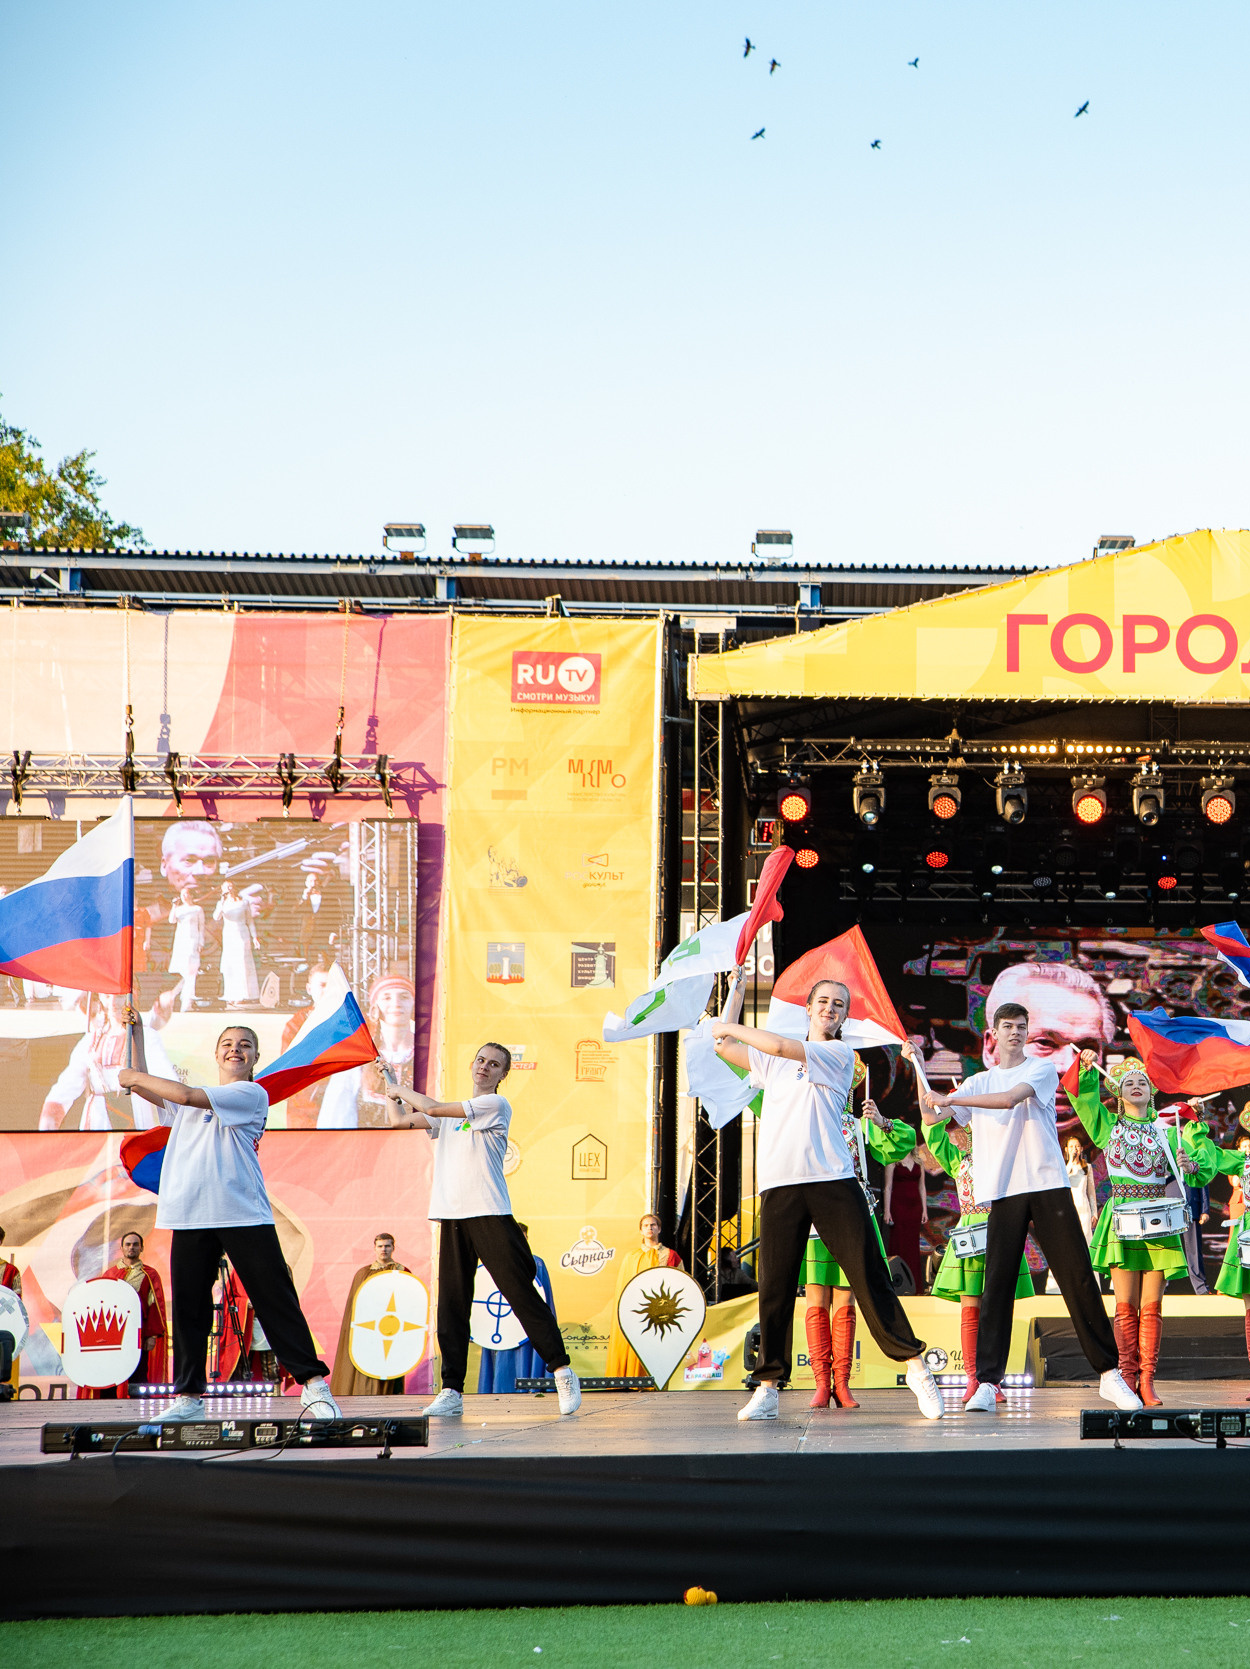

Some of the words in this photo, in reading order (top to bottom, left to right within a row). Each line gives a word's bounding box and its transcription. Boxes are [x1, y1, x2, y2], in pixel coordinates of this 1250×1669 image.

[517, 664, 555, 685] RU
[565, 669, 588, 682] TV
[516, 692, 553, 701] СМОТРИ
[555, 693, 595, 702] МУЗЫКУ!
[510, 707, 572, 715] Информационный
[579, 1152, 601, 1168] ЦЕХ
[561, 1249, 614, 1268] Сырная
